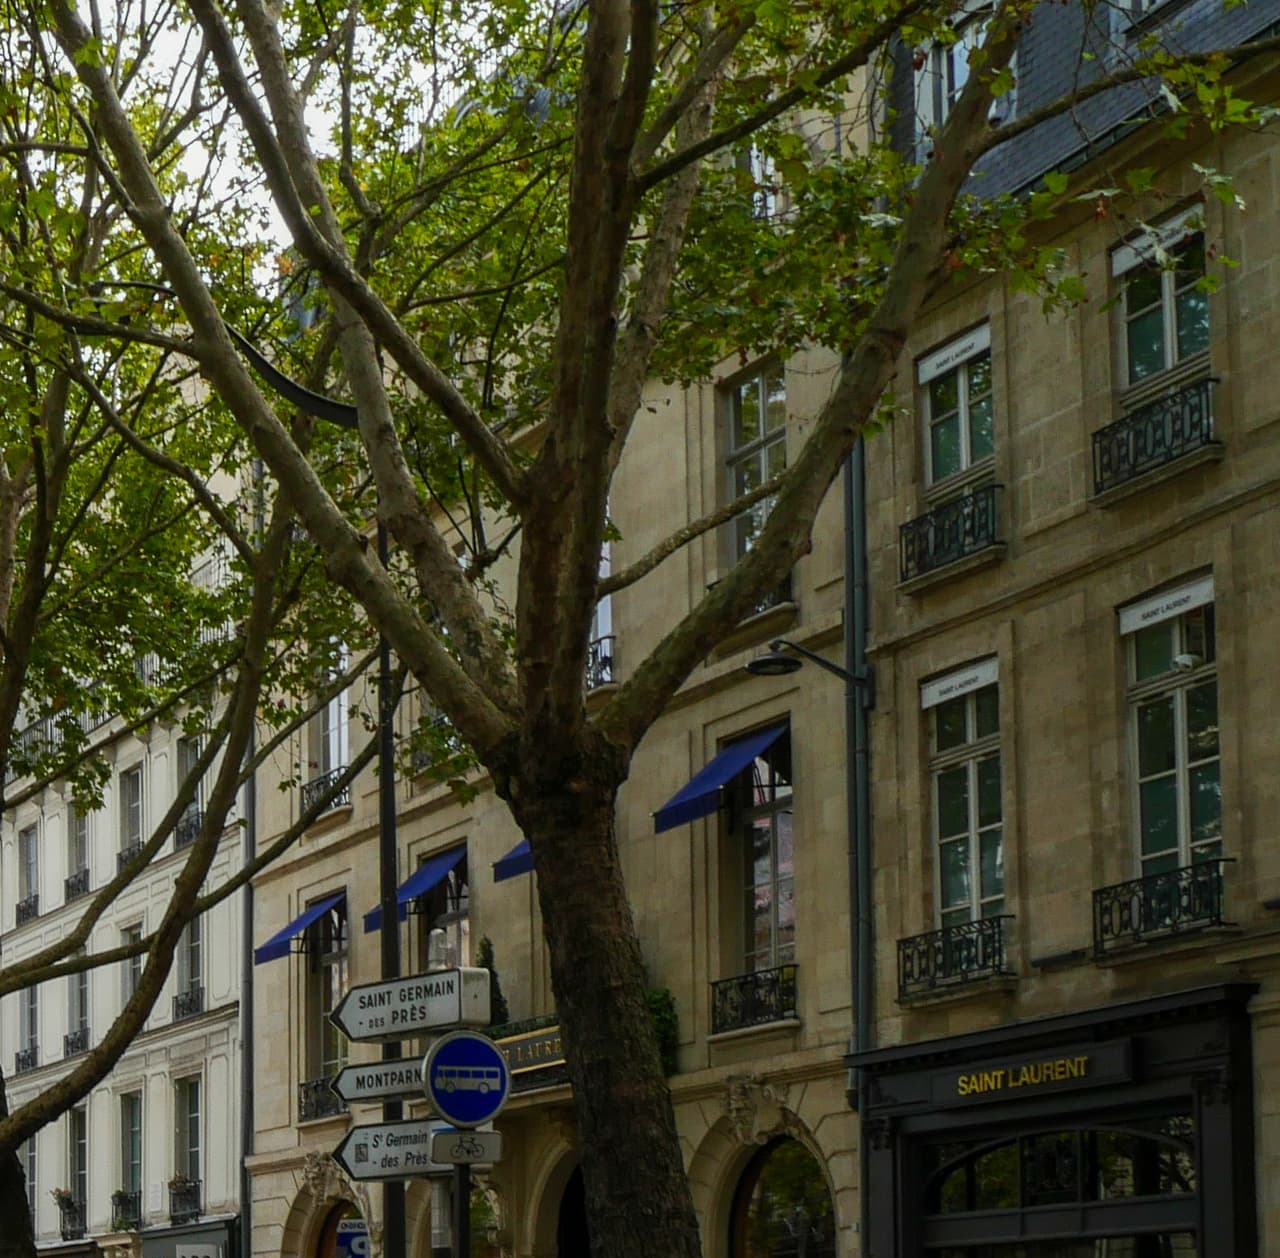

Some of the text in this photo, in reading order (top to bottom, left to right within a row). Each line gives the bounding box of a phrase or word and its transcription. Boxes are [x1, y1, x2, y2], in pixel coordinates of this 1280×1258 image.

[1142, 595, 1192, 620] SAINT LAURENT
[358, 979, 454, 1010] SAINT GERMAIN
[368, 1017, 385, 1029] DES
[392, 1004, 426, 1025] PRÈS
[958, 1056, 1088, 1095] SAINT LAURENT
[386, 1129, 427, 1148] Germain
[381, 1152, 399, 1168] des
[405, 1151, 428, 1167] Près
